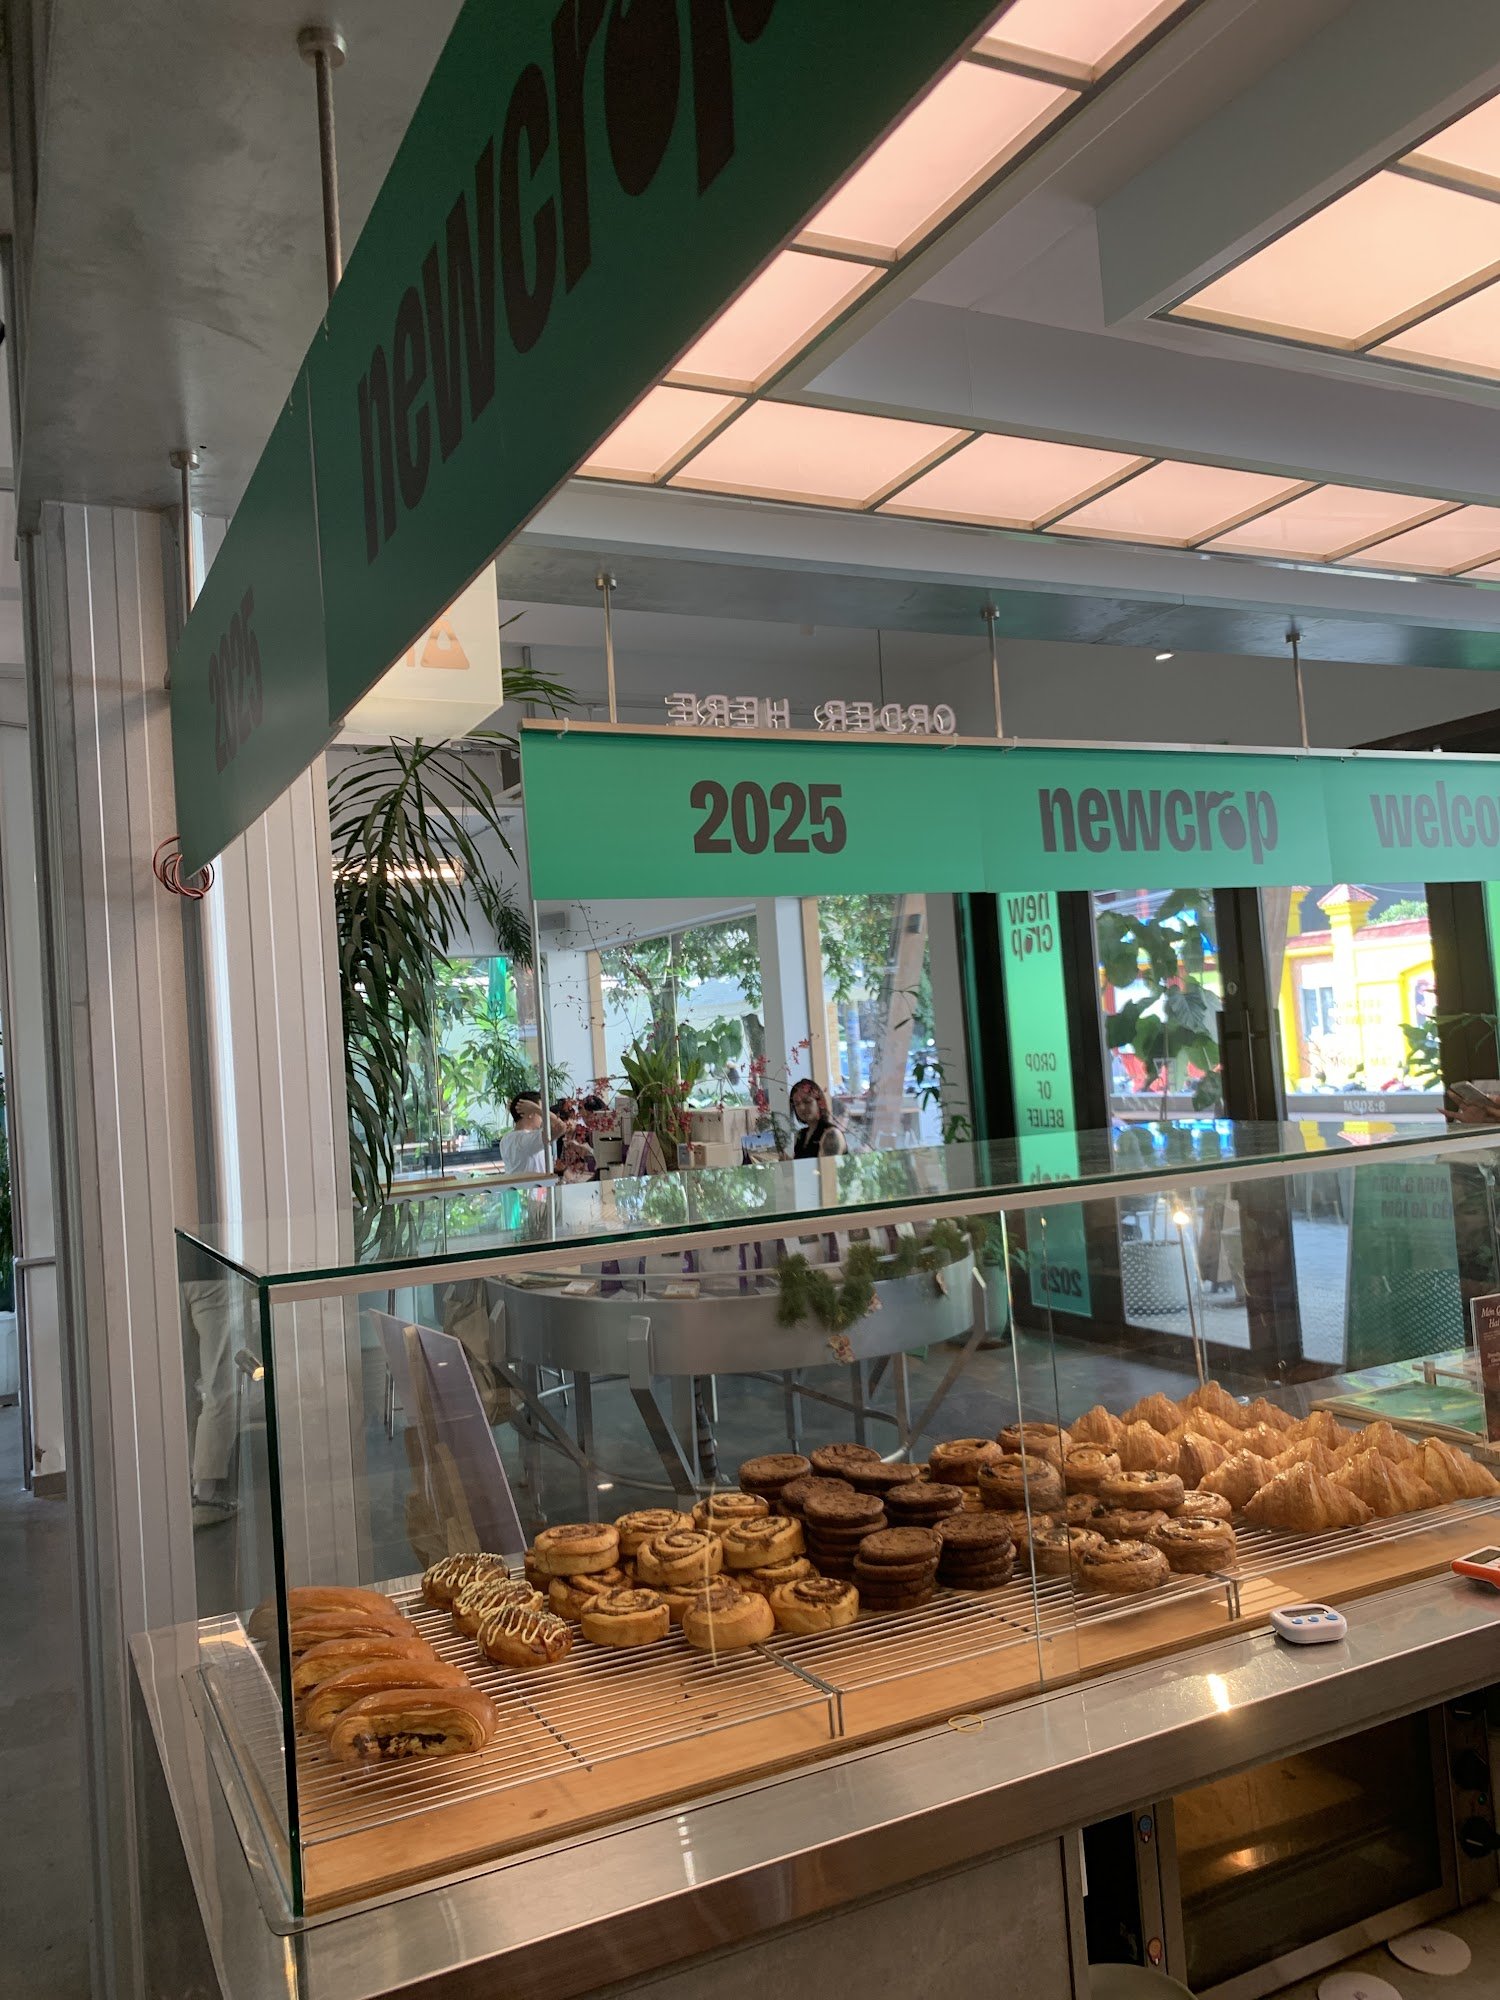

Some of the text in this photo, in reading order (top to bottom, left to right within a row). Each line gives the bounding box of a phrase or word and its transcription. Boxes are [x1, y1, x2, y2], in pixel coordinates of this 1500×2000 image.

[208, 584, 263, 775] 2025
[690, 780, 847, 855] 2025
[1038, 787, 1279, 865] newcrop
[1369, 780, 1500, 848] welco
